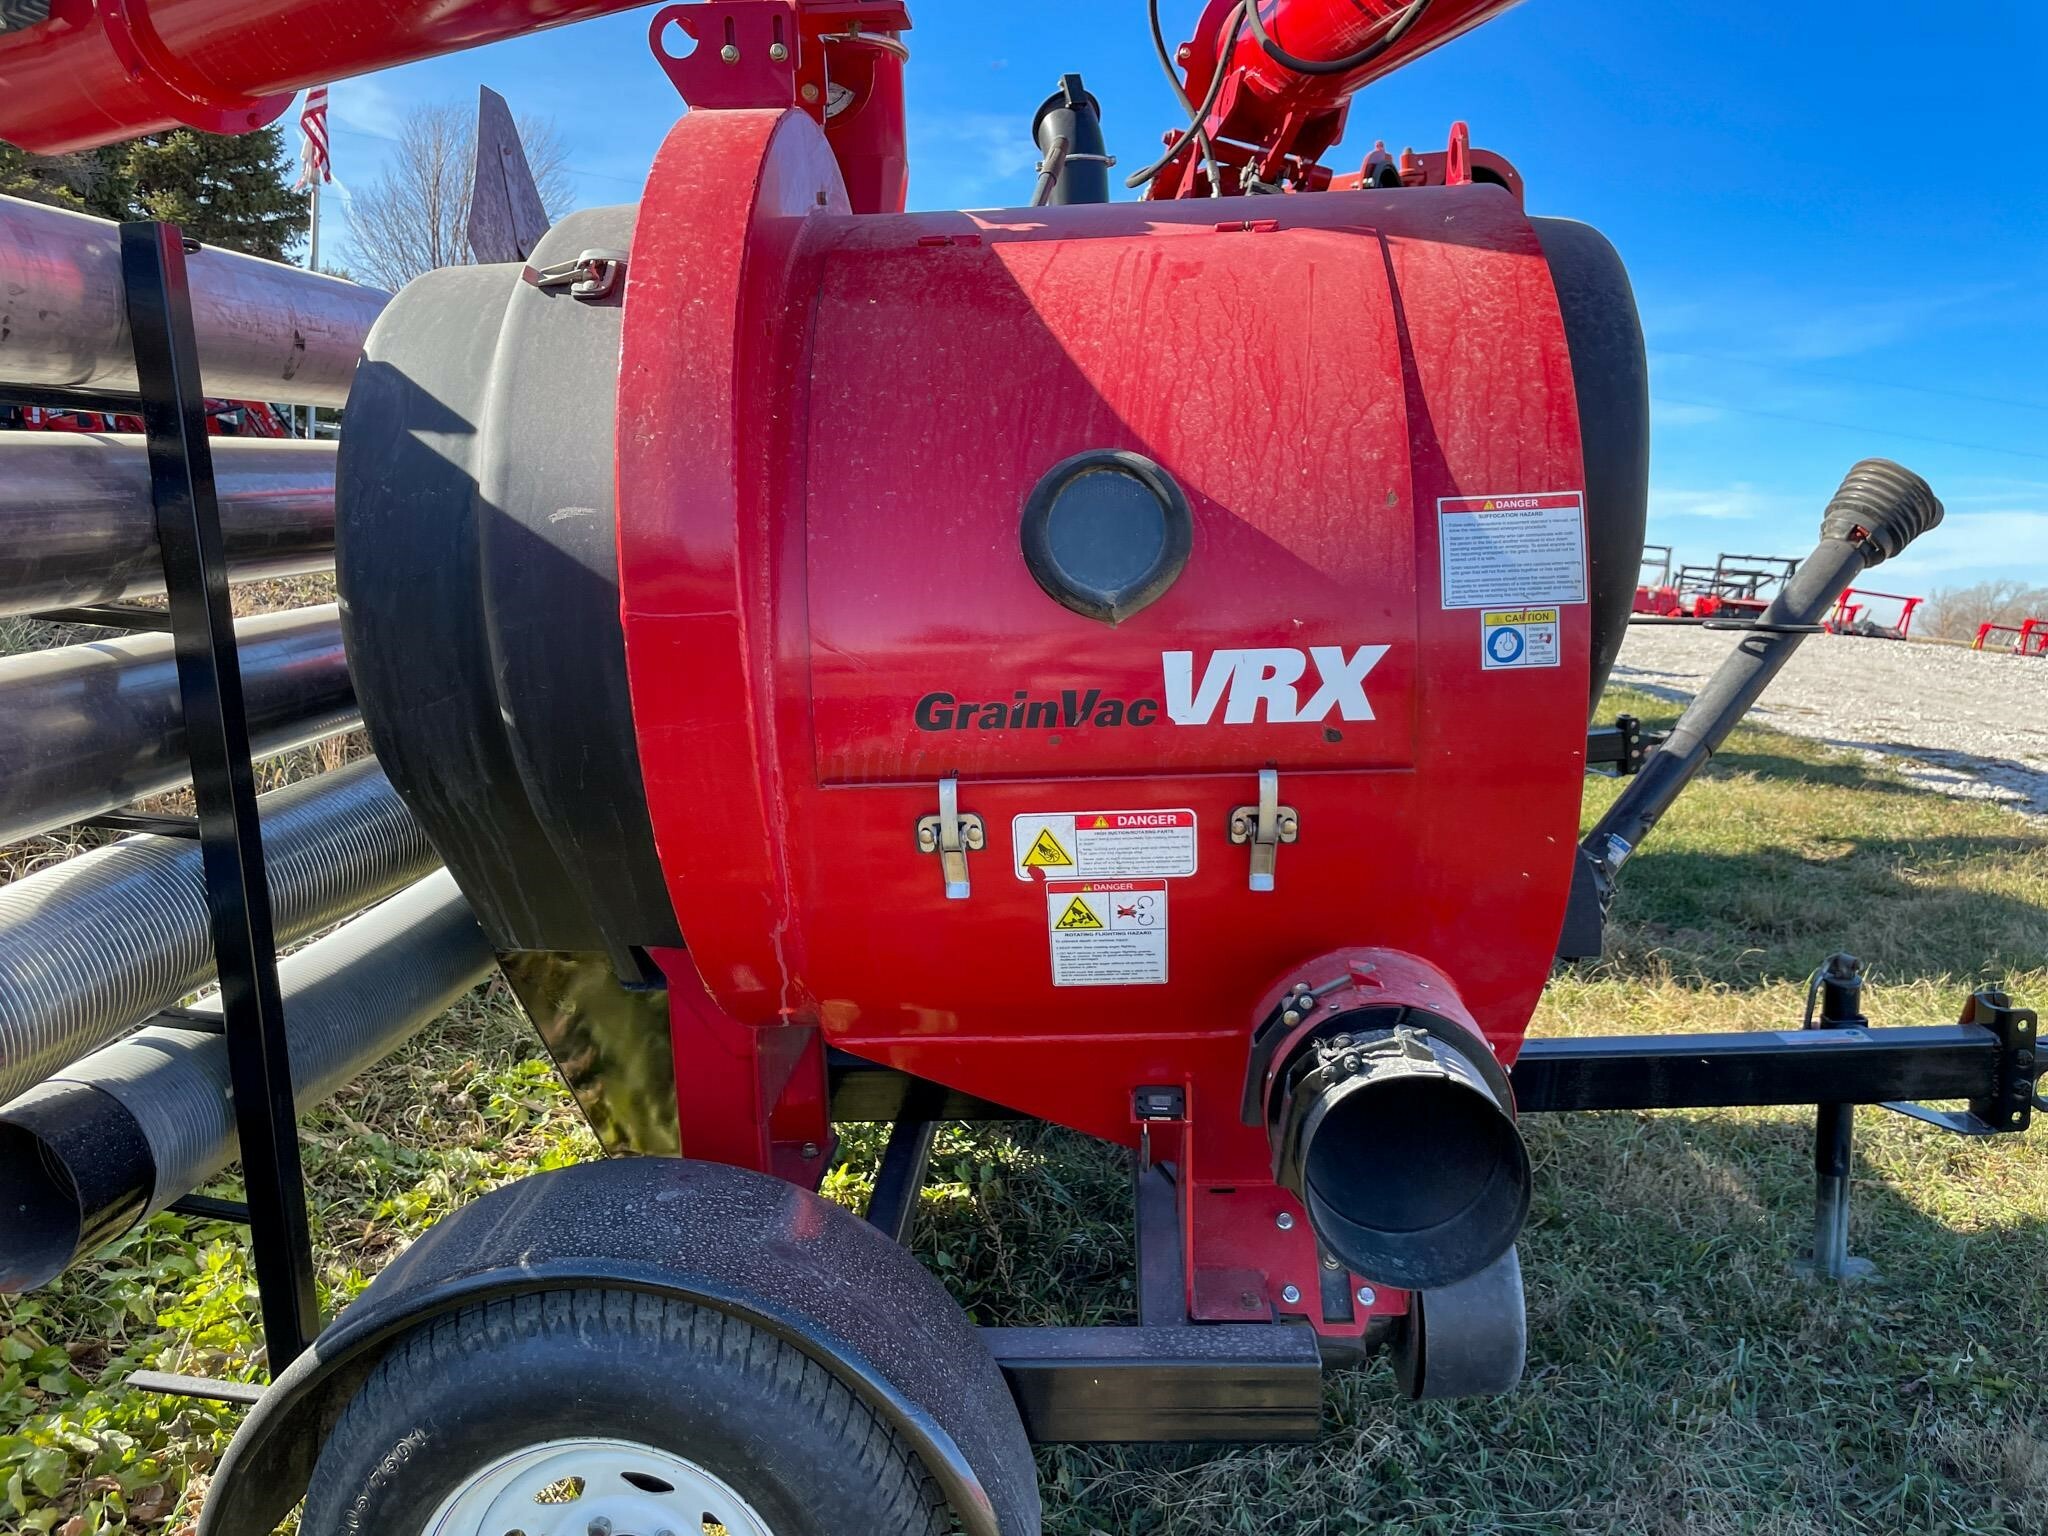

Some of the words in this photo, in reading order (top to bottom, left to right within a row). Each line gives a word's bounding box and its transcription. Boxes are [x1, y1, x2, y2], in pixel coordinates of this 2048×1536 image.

[1496, 499, 1539, 509] DANGER
[1478, 511, 1519, 519] SUFFOCATION
[914, 689, 1158, 732] GrainVac
[1161, 644, 1392, 726] VRX
[1117, 815, 1177, 826] DANGER
[1093, 883, 1134, 891] DANGER
